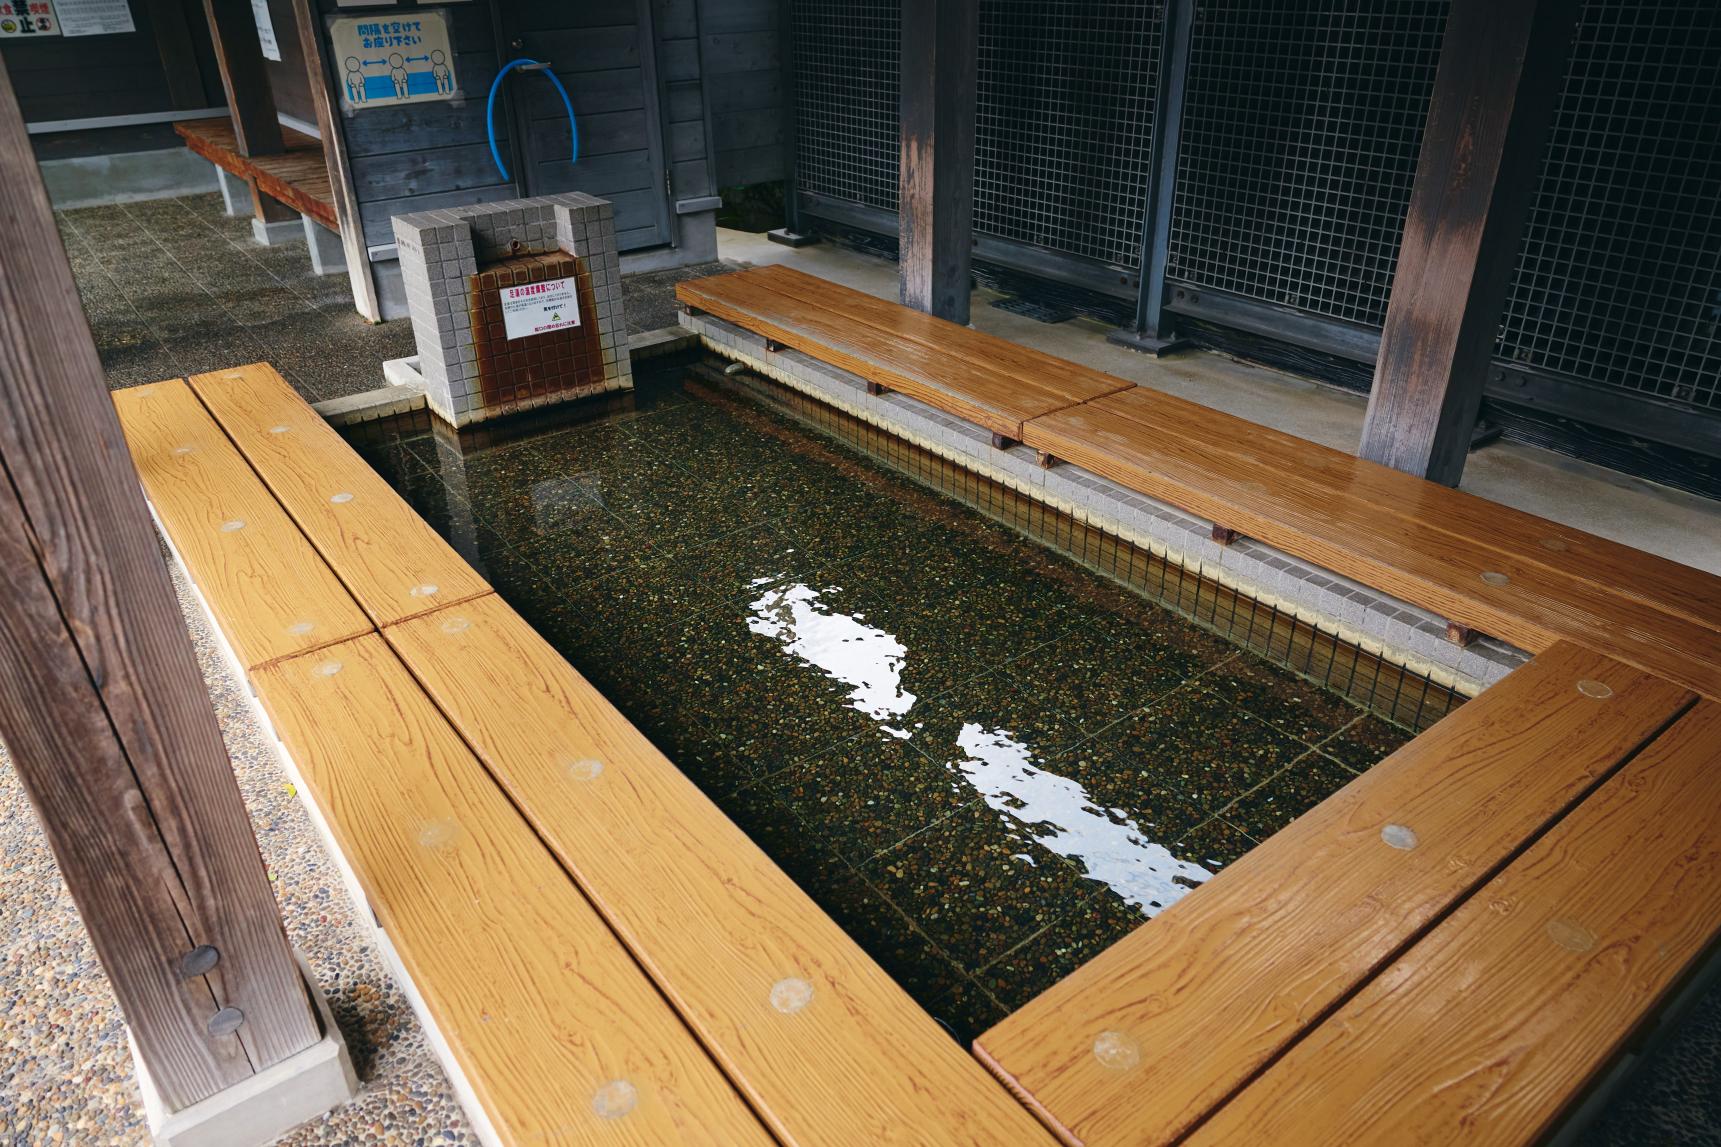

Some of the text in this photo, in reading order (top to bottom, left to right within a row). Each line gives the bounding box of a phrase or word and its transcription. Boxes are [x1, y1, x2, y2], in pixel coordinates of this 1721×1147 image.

[356, 21, 421, 36] 間隔を空けて
[362, 34, 421, 48] お座り下さい
